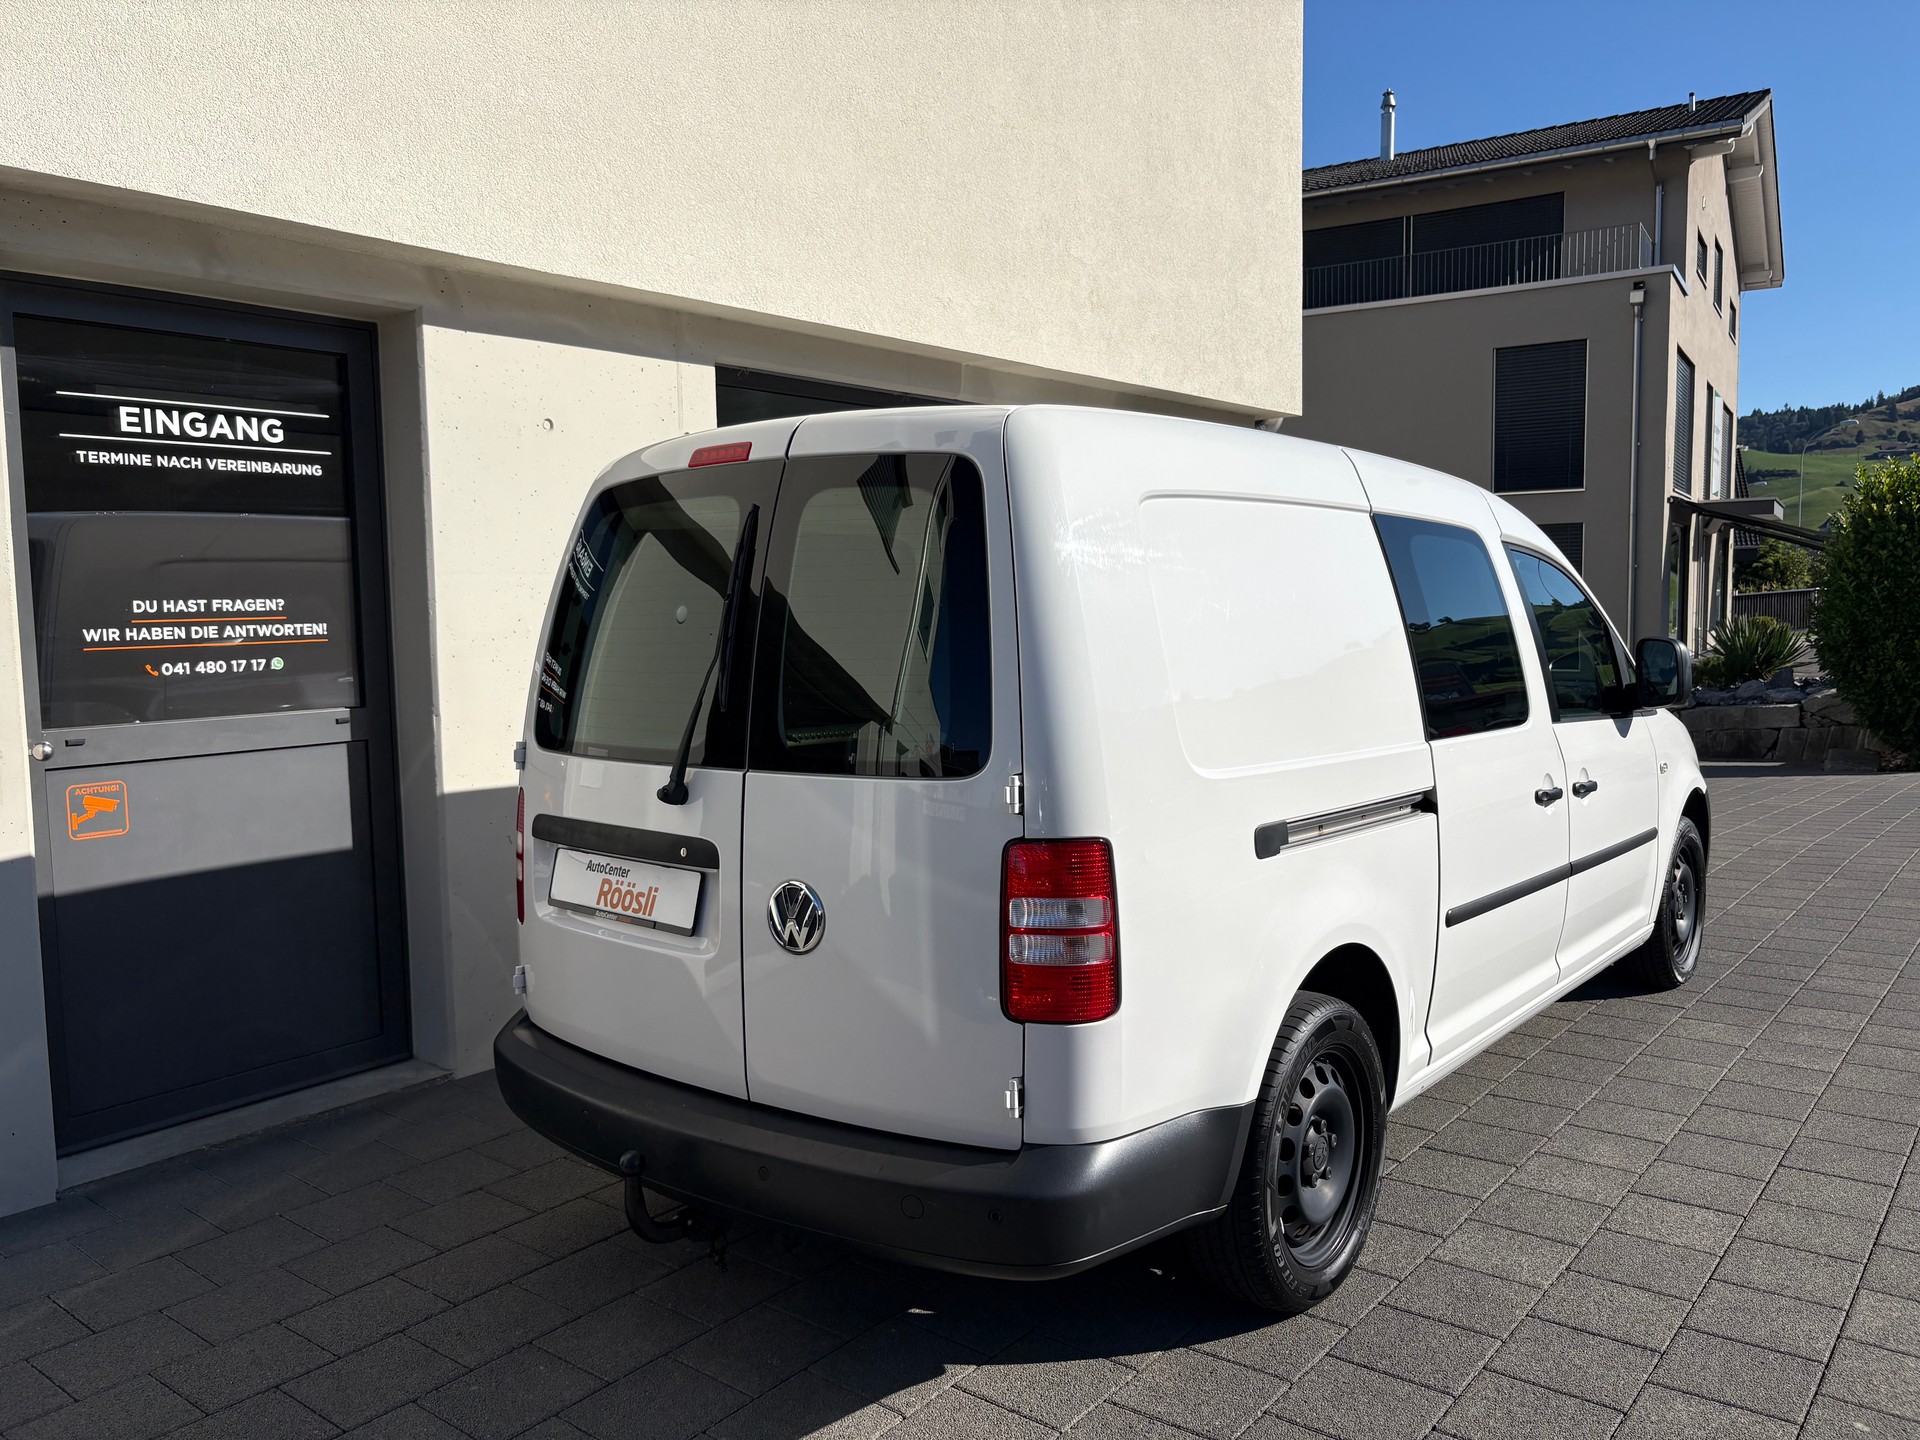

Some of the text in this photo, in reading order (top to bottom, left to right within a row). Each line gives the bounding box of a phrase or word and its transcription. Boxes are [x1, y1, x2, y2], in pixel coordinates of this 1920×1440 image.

[119, 405, 285, 444] EINGANG
[76, 450, 323, 477] TERMINE NACH VEREINBARUNG
[132, 598, 285, 614] DU HAST FRAGEN?
[82, 623, 328, 642] WIR HABEN DIE ANTWORTEN!
[161, 658, 267, 676] 041 480 17 17
[75, 785, 120, 796] ACHTUNG!
[585, 859, 631, 879] AutoCenter
[596, 878, 660, 917] Röösli
[769, 881, 825, 953] VW
